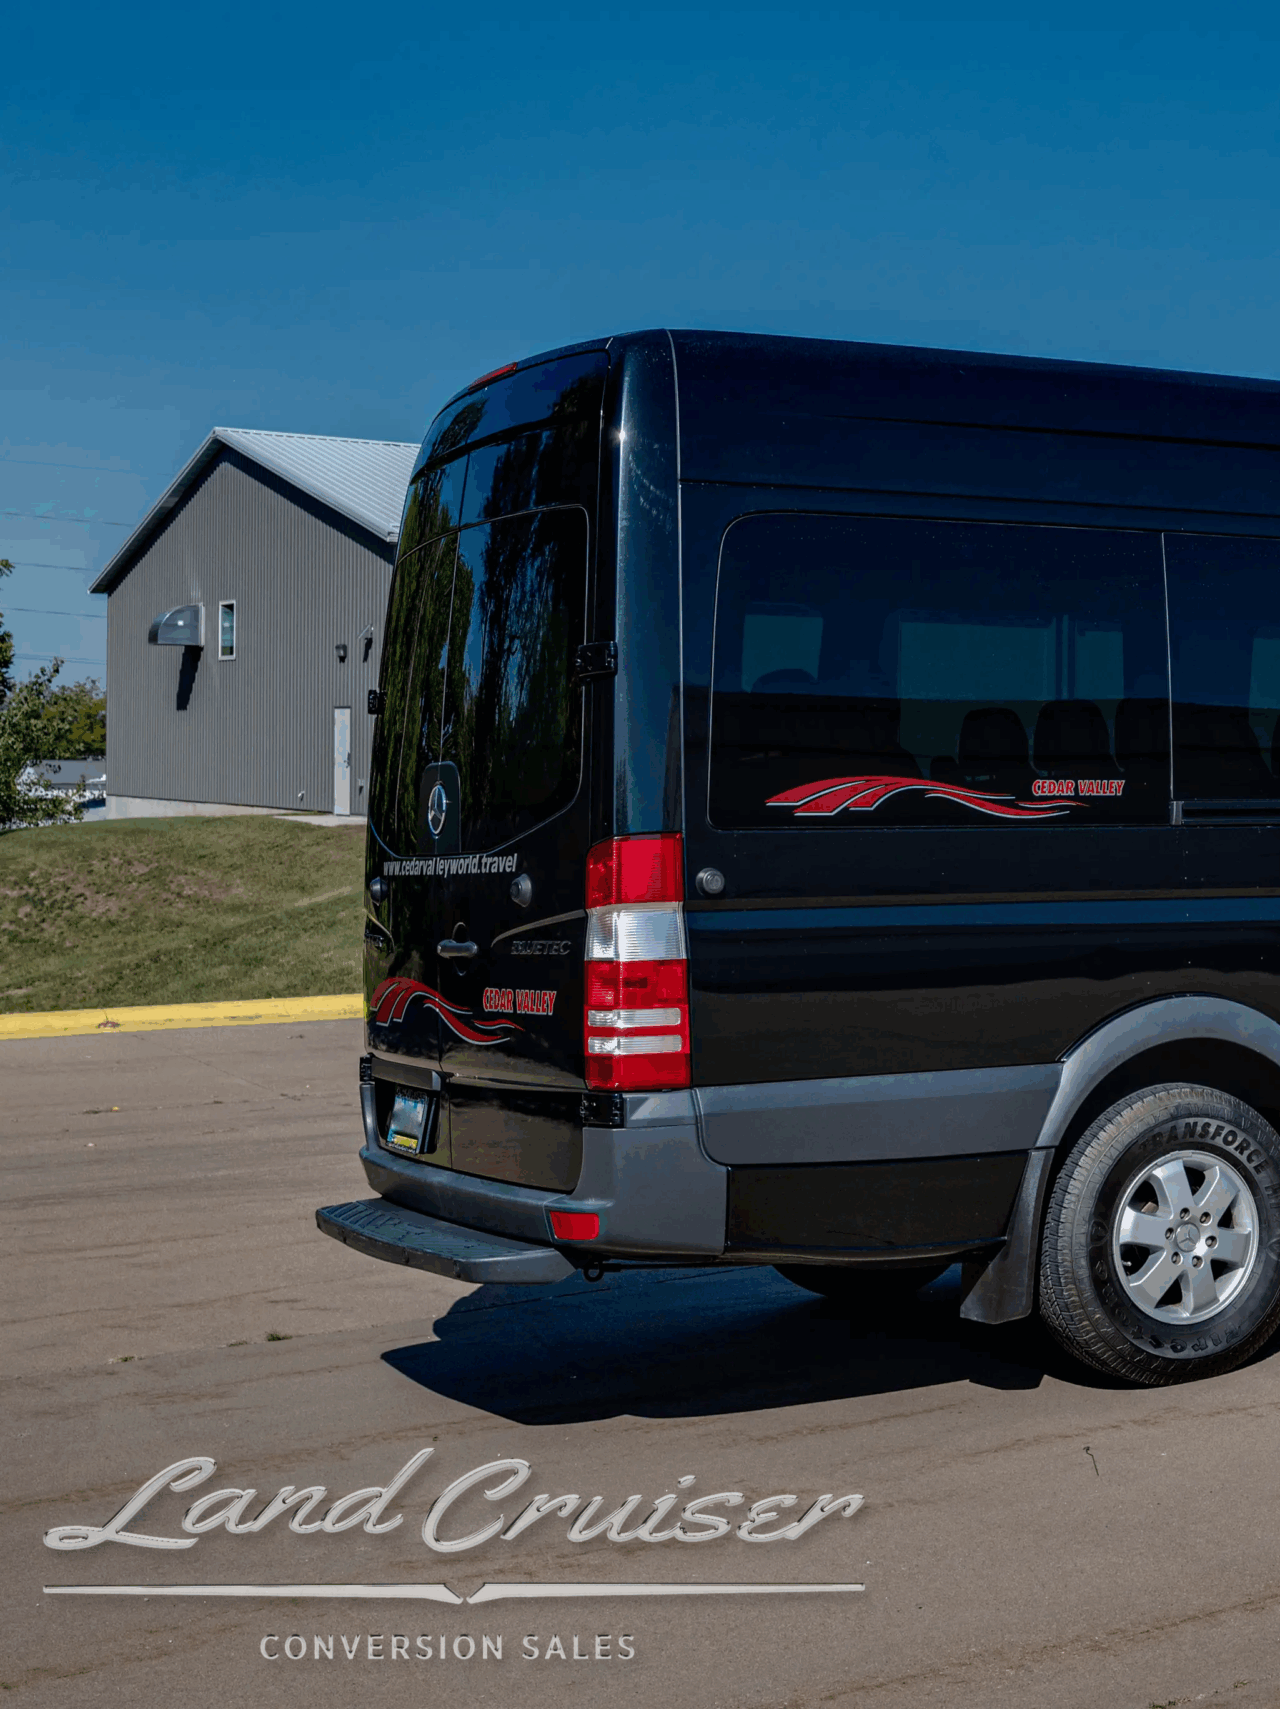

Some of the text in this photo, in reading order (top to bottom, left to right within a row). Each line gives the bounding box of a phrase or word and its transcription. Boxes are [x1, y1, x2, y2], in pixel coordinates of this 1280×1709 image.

[1032, 779, 1125, 796] CEDAR VALLEY
[383, 853, 518, 878] www.cedarvalleyworld.travel
[510, 940, 572, 955] BLUETEC
[483, 987, 557, 1016] CEDAR VALLEY
[1139, 1120, 1267, 1176] TRANSFORCE
